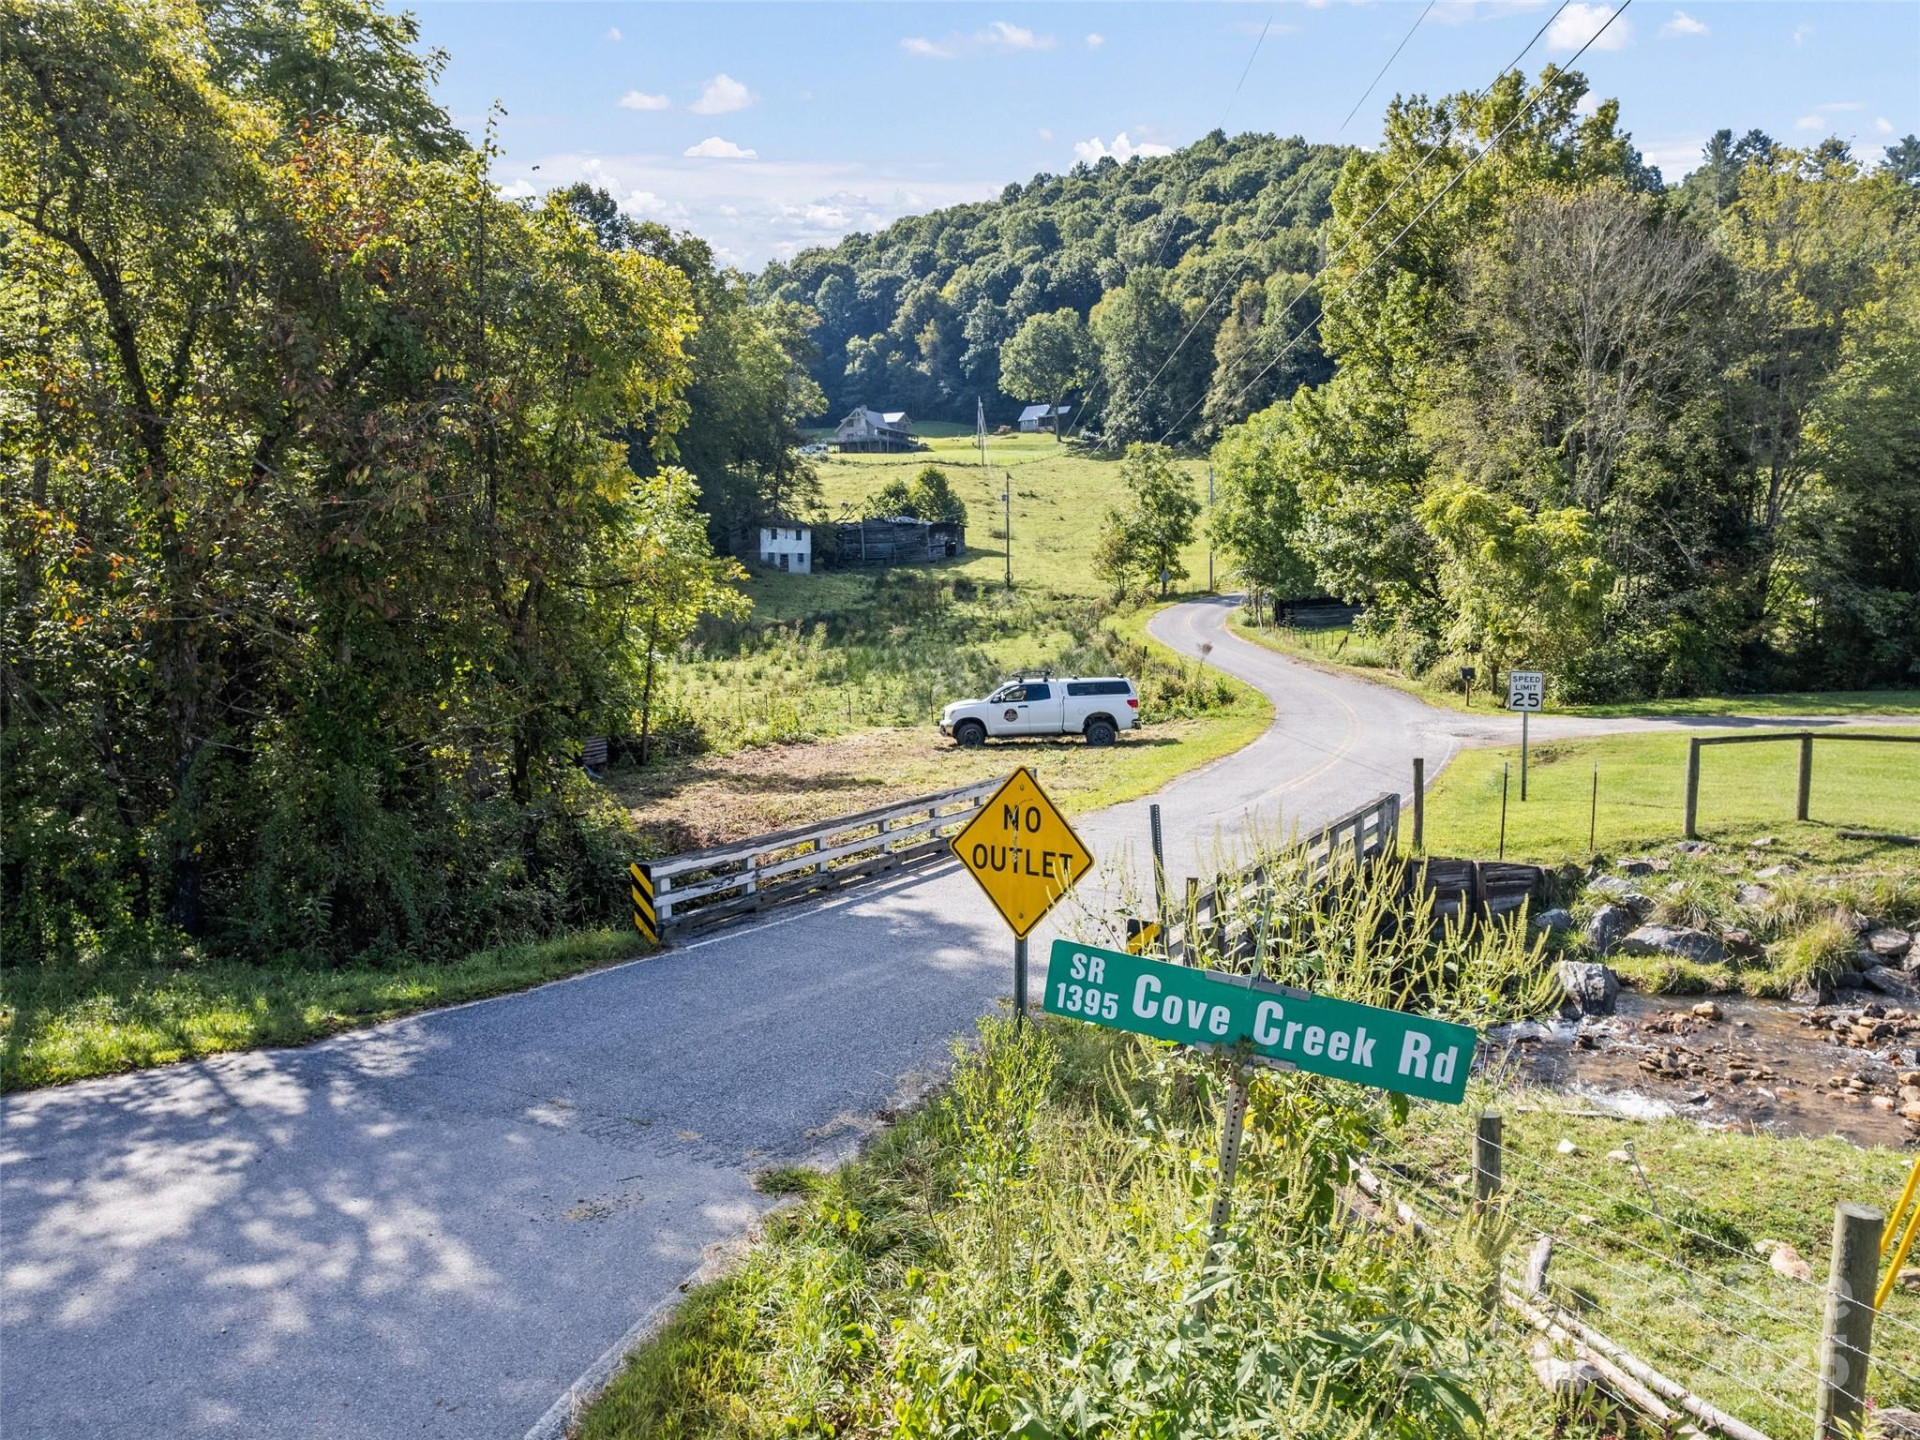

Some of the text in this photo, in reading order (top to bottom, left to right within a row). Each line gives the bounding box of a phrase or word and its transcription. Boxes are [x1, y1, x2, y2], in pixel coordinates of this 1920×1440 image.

[1512, 675, 1541, 683] SPEED
[1512, 692, 1540, 707] 25
[1003, 804, 1042, 833] NO
[972, 843, 1073, 879] OUTLET
[1070, 952, 1107, 985] SR
[1056, 981, 1119, 1020] 1395
[1131, 973, 1459, 1085] Cove Creek Rd
